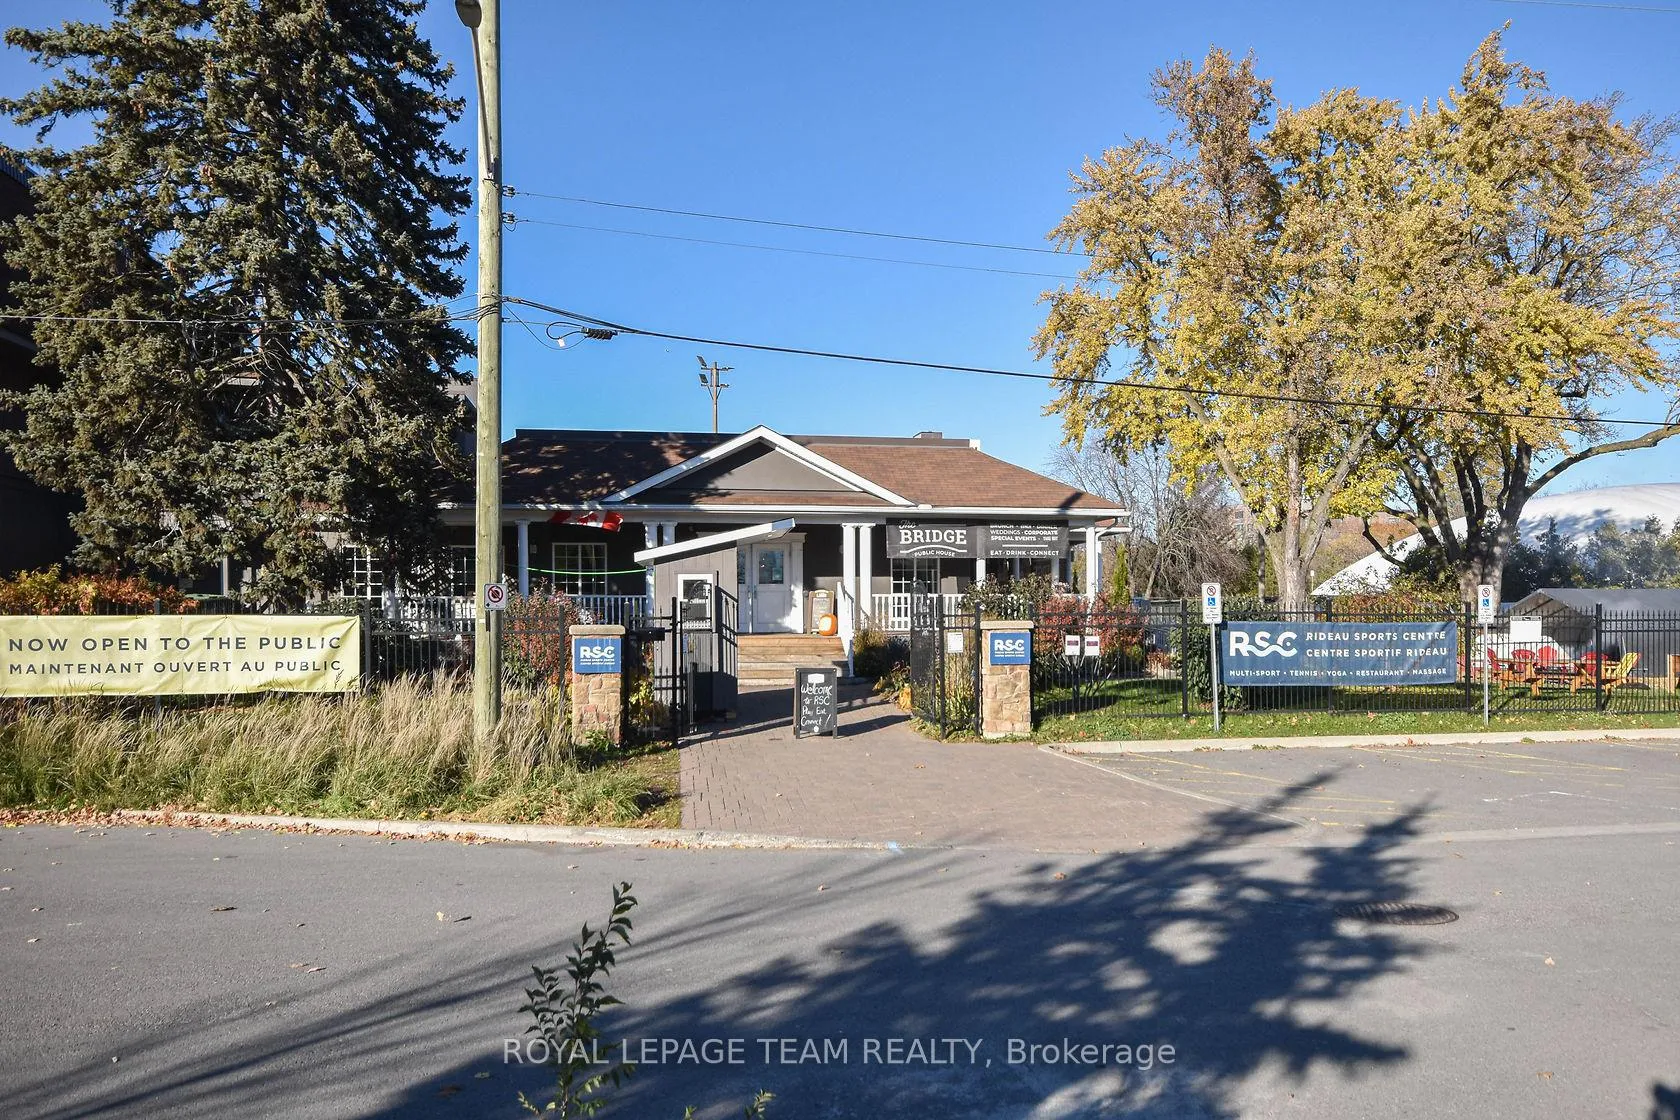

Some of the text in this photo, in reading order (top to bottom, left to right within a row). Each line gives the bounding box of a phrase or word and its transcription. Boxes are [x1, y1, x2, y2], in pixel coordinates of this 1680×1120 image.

[899, 529, 967, 545] BRIDGE
[914, 549, 935, 557] PUBLIC
[1306, 631, 1446, 641] RIDEAU SPORTS CENTRE
[9, 636, 341, 652] NOW OPEN TO THE PUBLIC
[994, 639, 1025, 651] RSC
[1229, 631, 1298, 657] RSC
[580, 645, 615, 659] RSC
[1306, 647, 1447, 658] CENTRE SPORTIF RIDEAU
[9, 660, 341, 675] MAINTENANT OUVERT AU PUBLIC
[801, 683, 833, 696] Welcome
[814, 696, 830, 705] RSC
